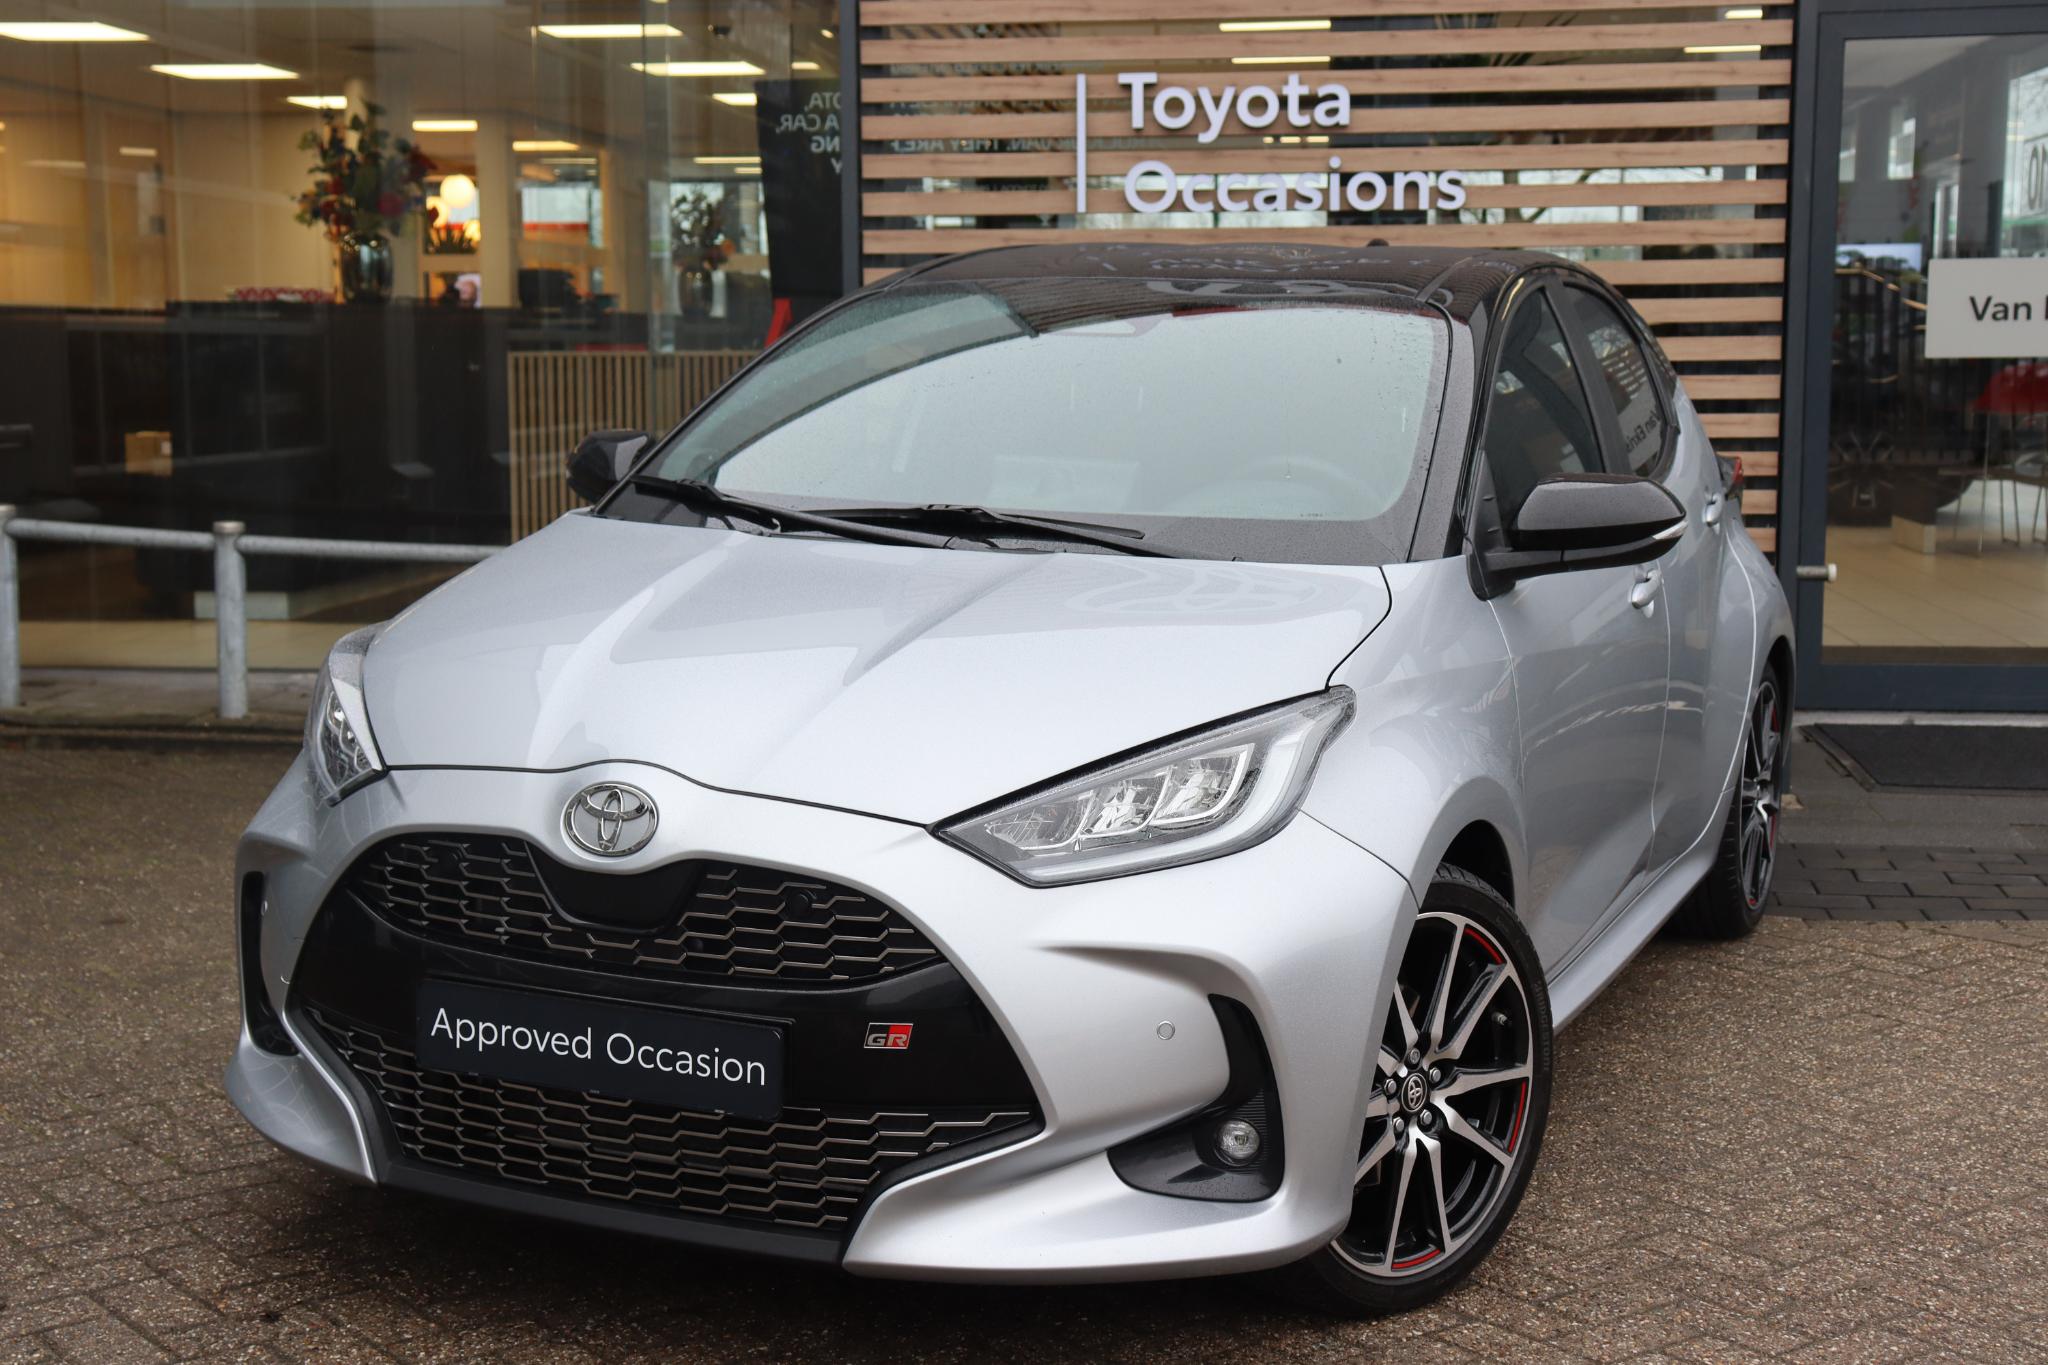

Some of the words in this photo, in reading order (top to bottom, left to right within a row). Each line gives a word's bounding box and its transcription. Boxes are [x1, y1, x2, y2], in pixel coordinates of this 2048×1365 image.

[1118, 72, 1351, 144] Toyota
[1124, 156, 1467, 214] Occasions
[1969, 295, 2032, 321] Van
[431, 1007, 592, 1060] Approved
[606, 1032, 766, 1086] Occasion
[866, 1031, 909, 1047] GR
